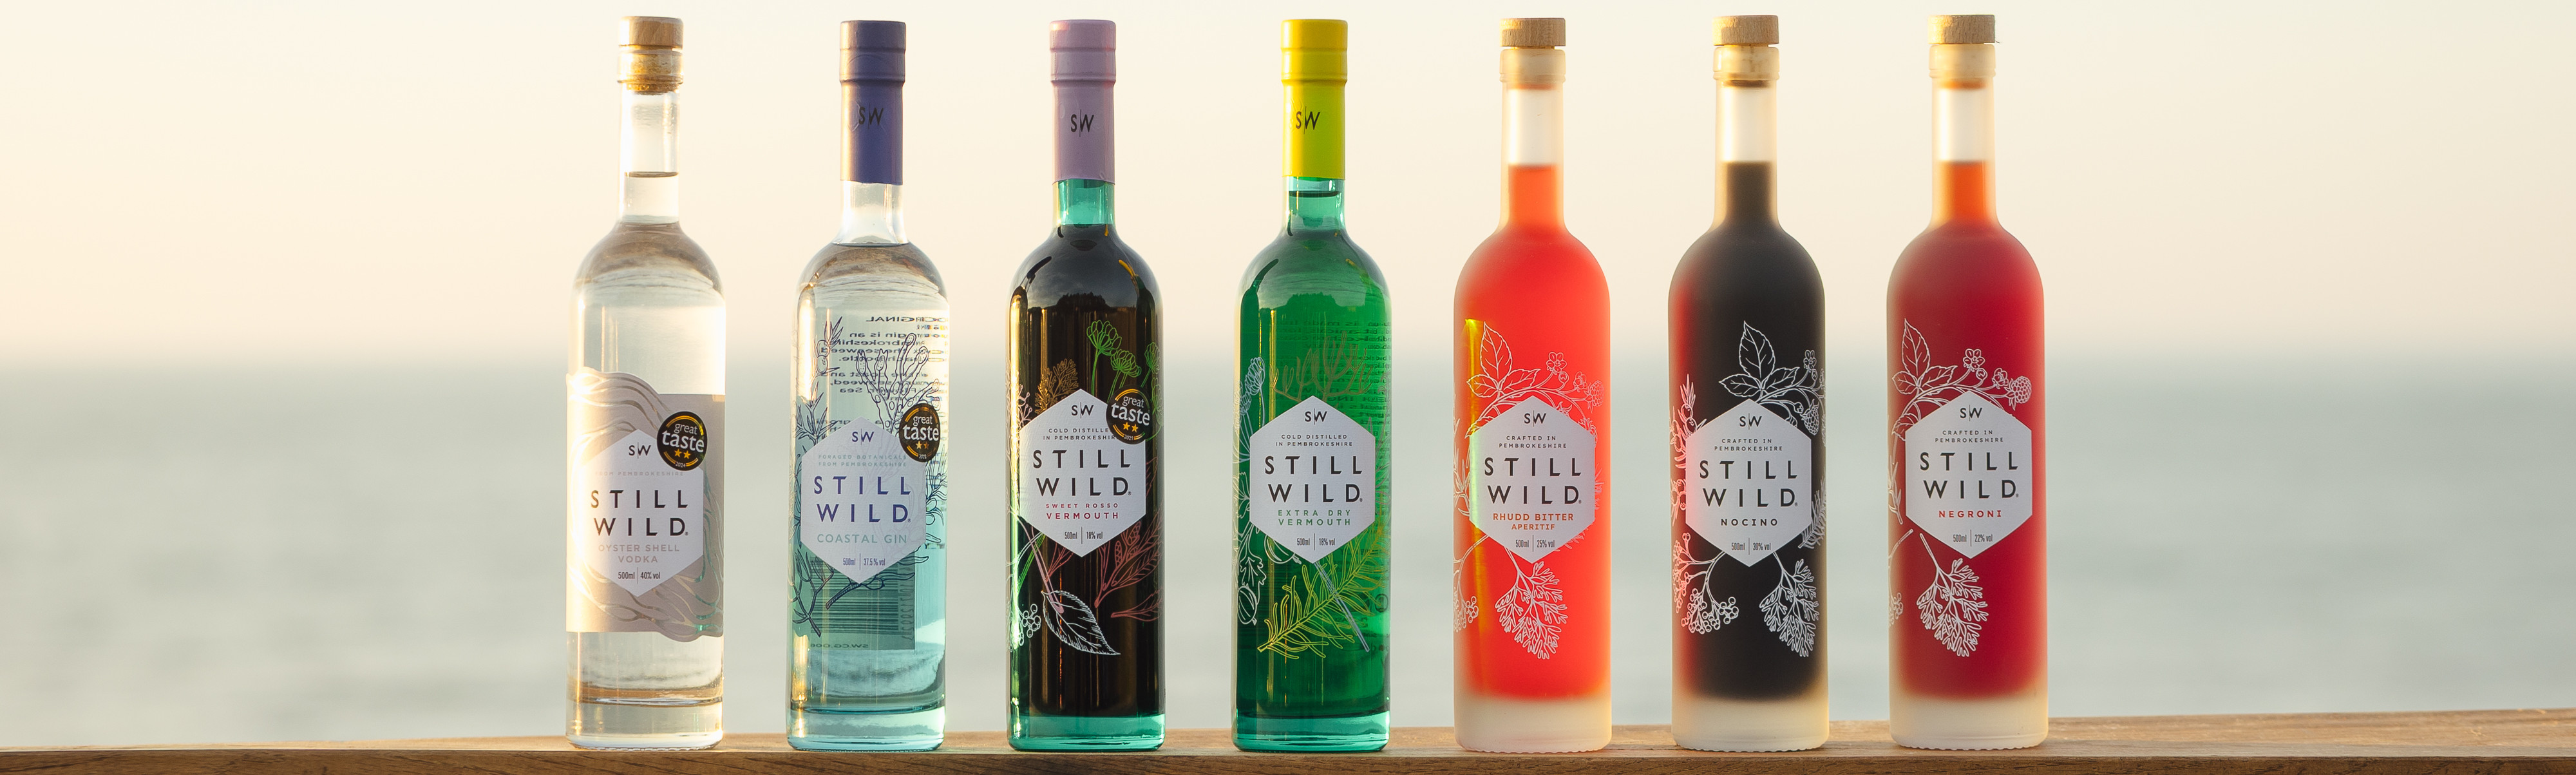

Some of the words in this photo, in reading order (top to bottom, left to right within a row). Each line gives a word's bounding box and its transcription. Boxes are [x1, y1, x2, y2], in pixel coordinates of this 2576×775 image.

[1122, 396, 1144, 408] great
[913, 415, 933, 426] great
[1111, 403, 1150, 426] taste
[674, 423, 698, 435] great
[902, 425, 939, 441] taste
[662, 430, 705, 452] taste
[1033, 449, 1131, 468] STILL
[1265, 455, 1362, 474] STILL
[1484, 457, 1581, 476] STILL
[1920, 452, 2018, 471] STILL
[1700, 460, 1797, 479] STILL
[814, 476, 911, 495] STILL
[591, 490, 688, 508] STILL
[817, 534, 878, 544] COASTAL
[884, 534, 907, 543] GIN
[1953, 534, 1967, 542] 500ml
